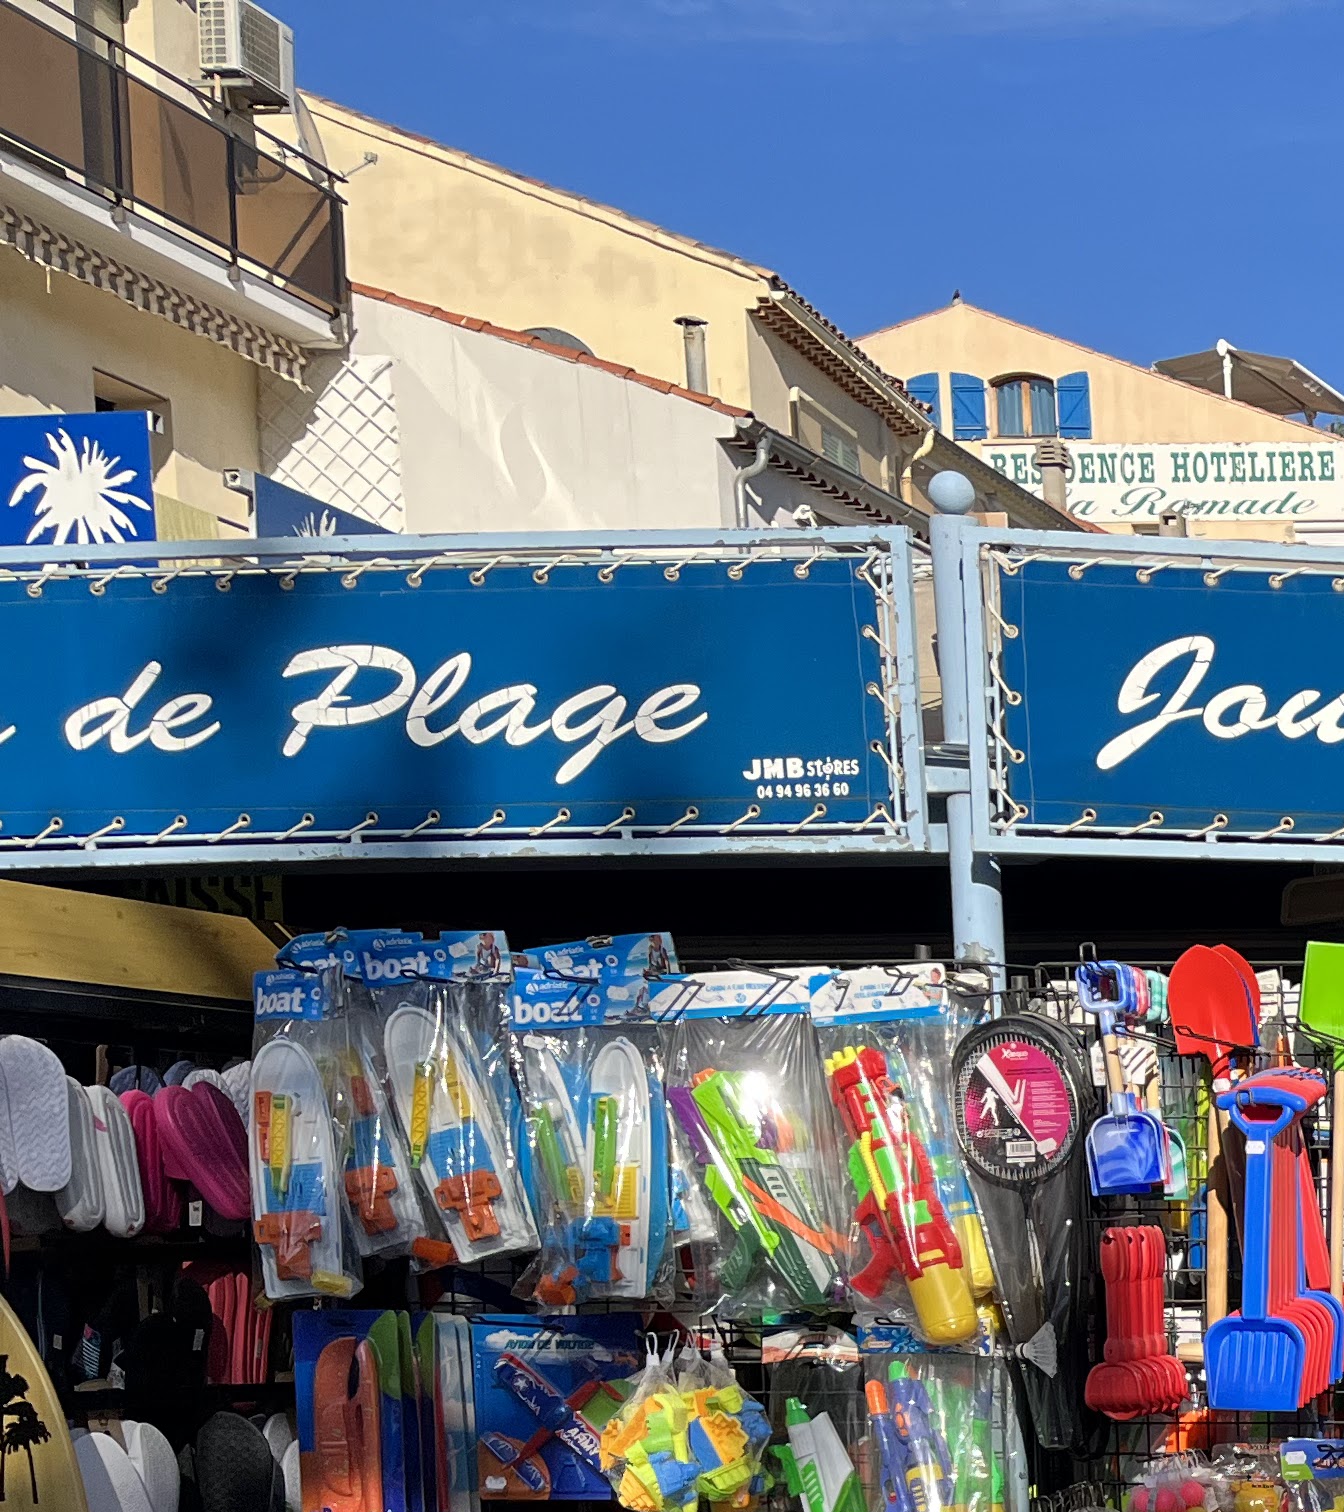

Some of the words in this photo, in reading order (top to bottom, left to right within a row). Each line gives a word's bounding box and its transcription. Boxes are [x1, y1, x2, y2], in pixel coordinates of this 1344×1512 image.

[990, 451, 1155, 484] RESENCE
[1170, 450, 1335, 483] HOTELIERE
[64, 660, 221, 752] de
[281, 644, 709, 786] Plage
[742, 757, 804, 780] JMB
[756, 785, 773, 799] 04
[775, 784, 792, 798] 94
[795, 783, 811, 797] 96
[814, 783, 830, 797] 36
[833, 782, 849, 796] 60
[363, 951, 431, 980] boat
[256, 986, 306, 1016] boat
[513, 994, 583, 1025] boat
